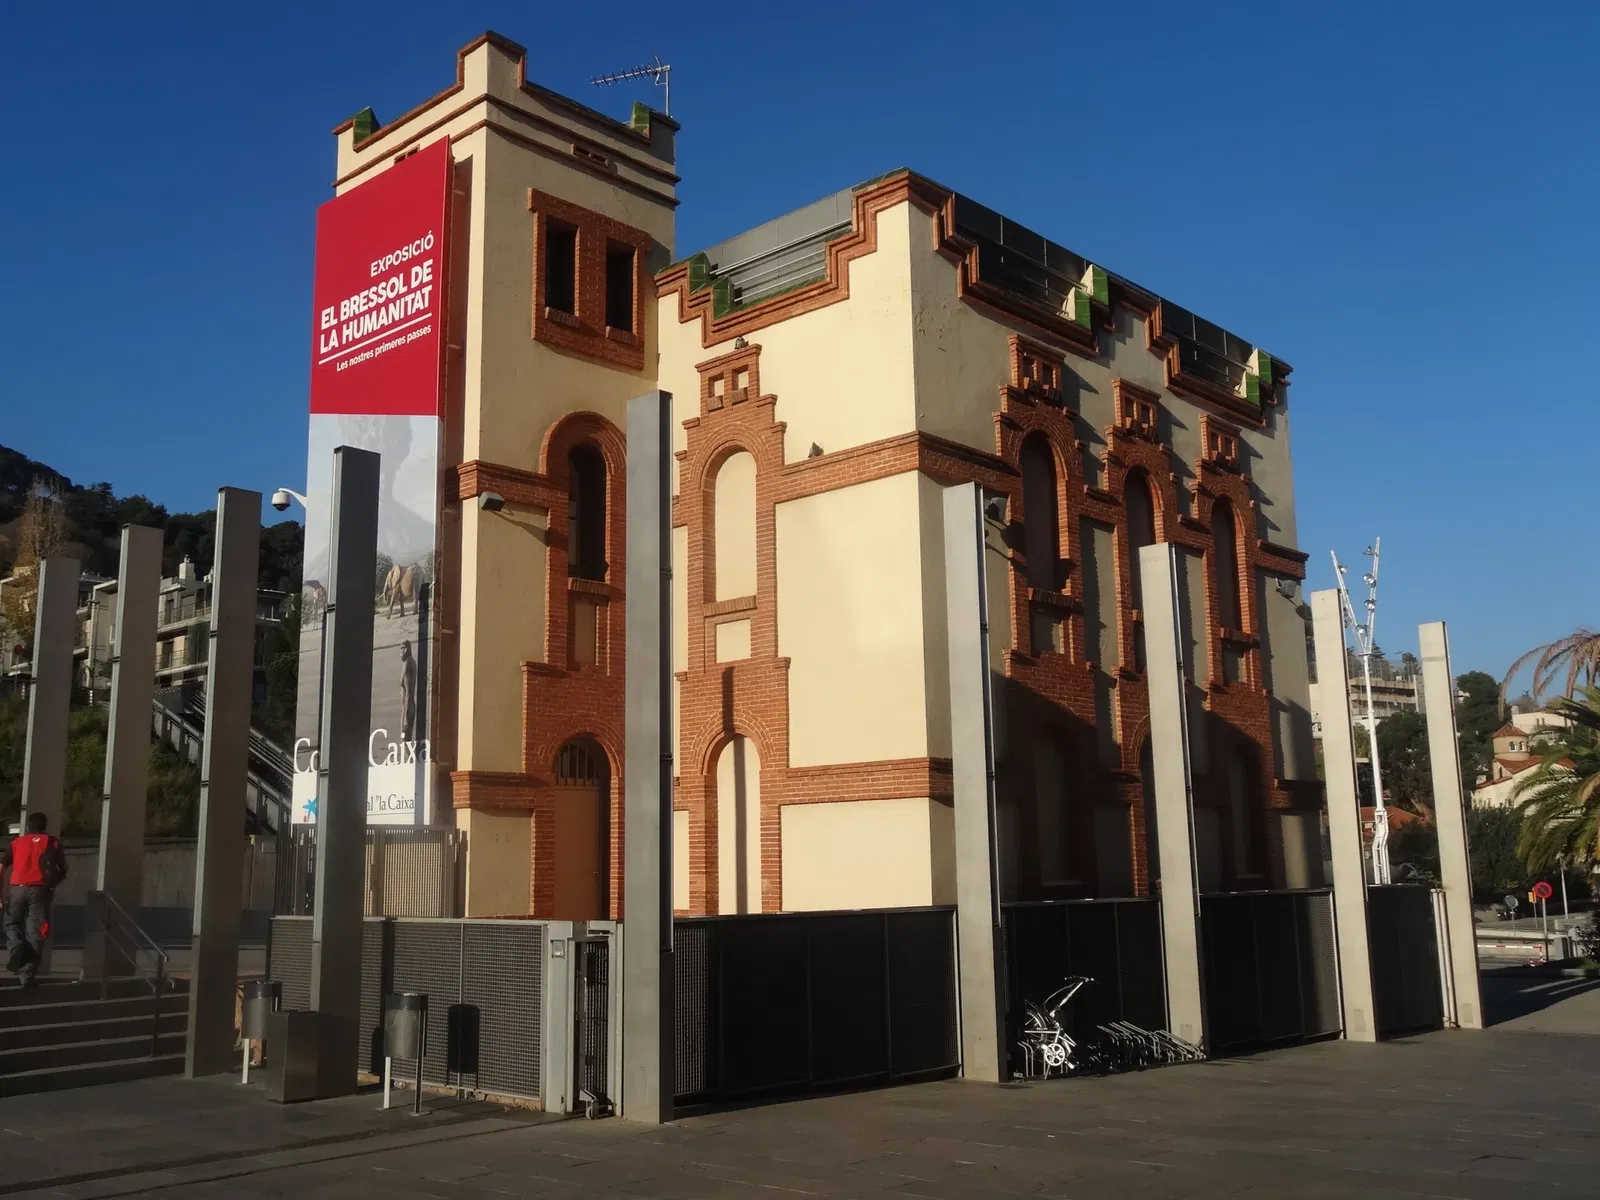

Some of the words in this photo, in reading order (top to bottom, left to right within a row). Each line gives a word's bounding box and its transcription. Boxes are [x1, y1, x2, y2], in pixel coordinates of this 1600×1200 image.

[370, 230, 434, 277] EXPOSICIÓ
[320, 329, 339, 354] LA
[342, 285, 433, 344] HUMANITAT
[321, 306, 338, 330] EL
[340, 273, 408, 321] BRESSOL
[410, 259, 433, 289] DE
[336, 362, 348, 372] Les
[349, 351, 374, 366] nostres
[375, 337, 406, 357] primeres
[407, 325, 432, 343] passes
